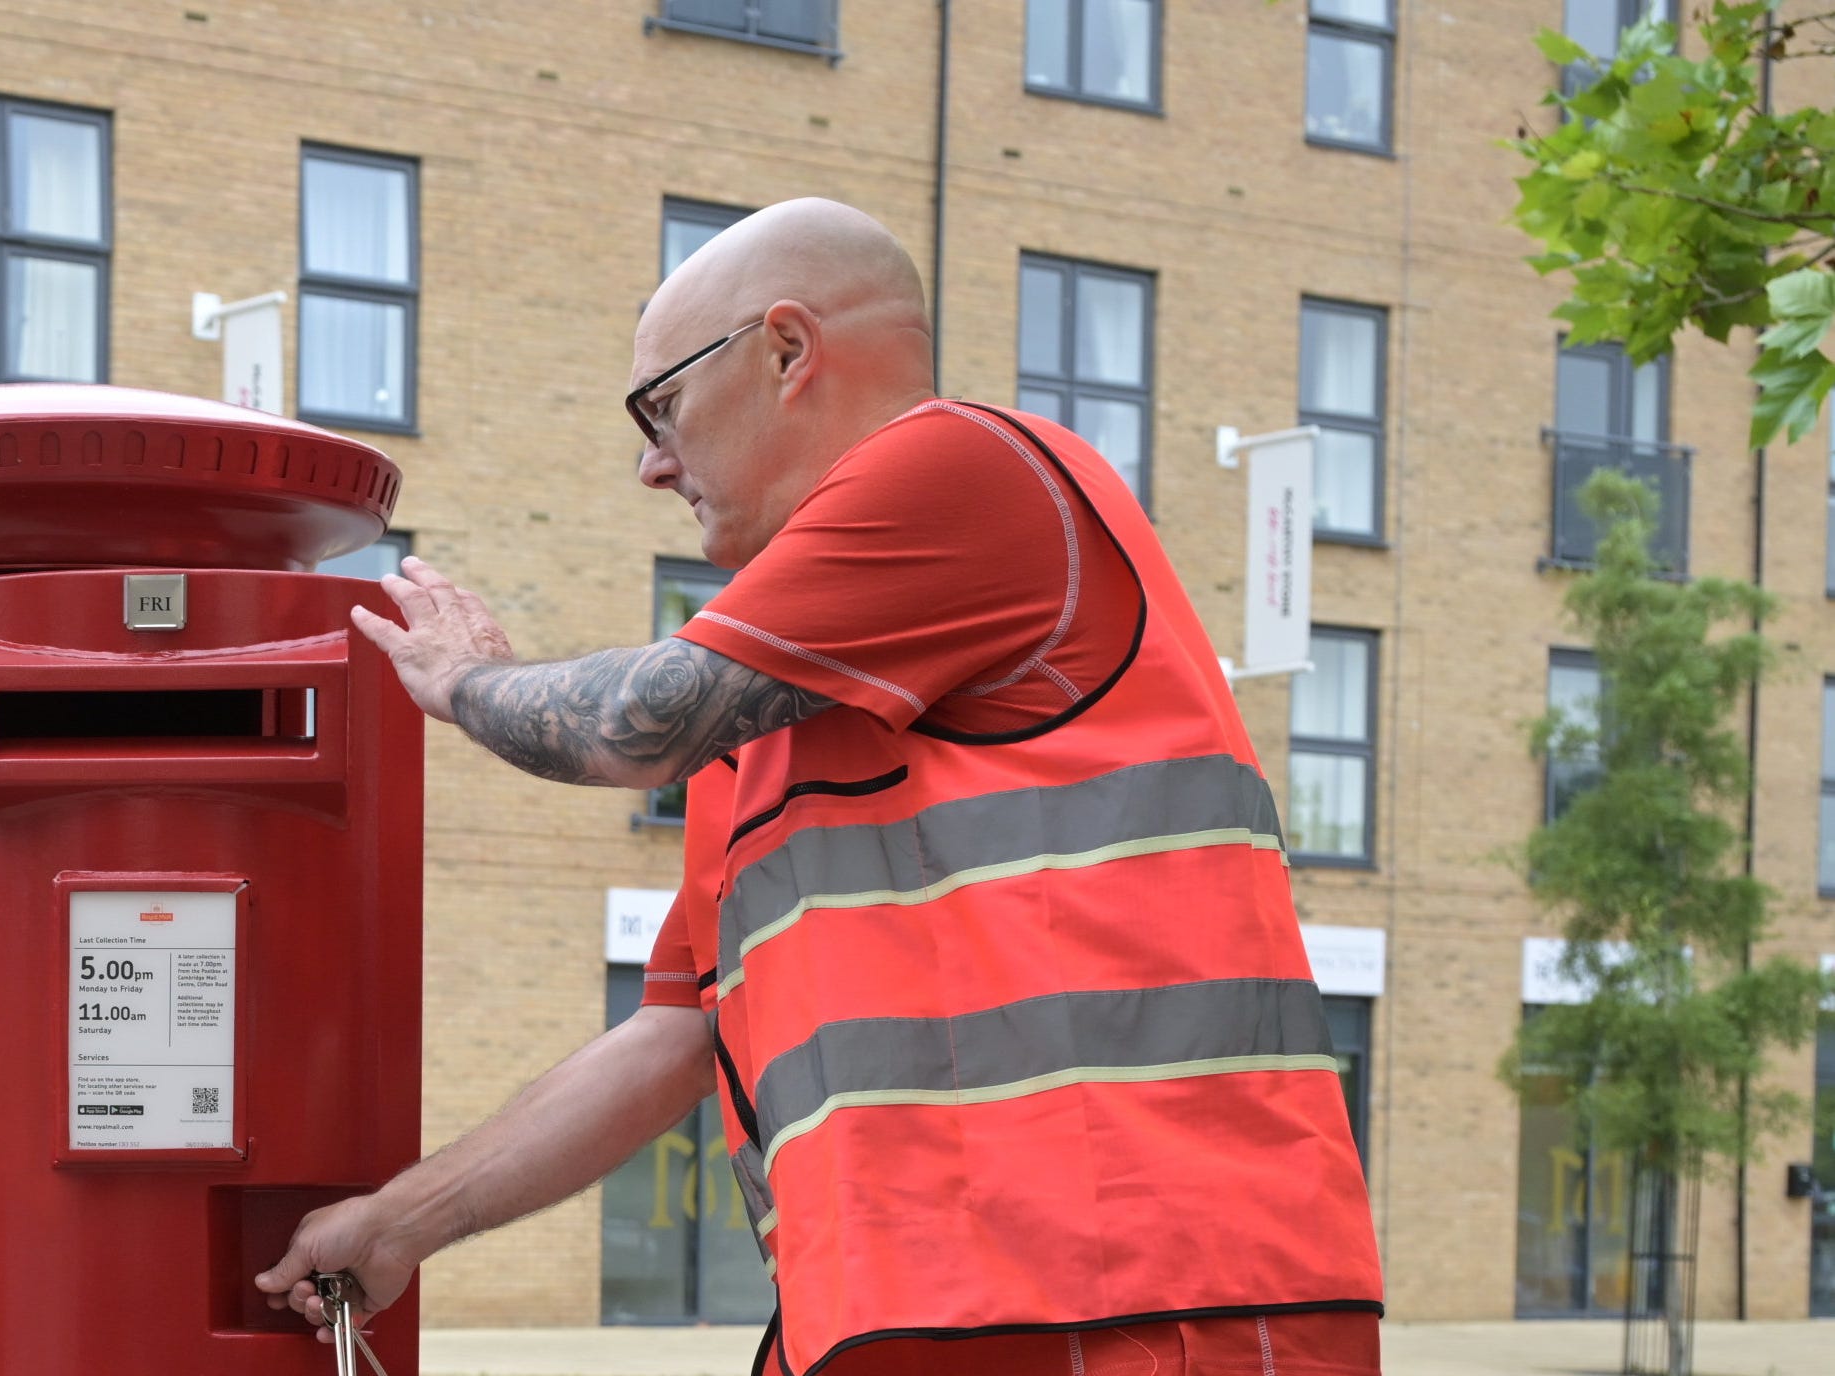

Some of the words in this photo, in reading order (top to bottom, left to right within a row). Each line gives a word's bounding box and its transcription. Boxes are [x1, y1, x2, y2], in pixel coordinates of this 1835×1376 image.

[139, 596, 172, 612] FRI
[80, 956, 154, 982] 5.00pm
[79, 1003, 147, 1021] 11.00am
[78, 1027, 112, 1035] Saturday
[78, 1053, 109, 1061] Services
